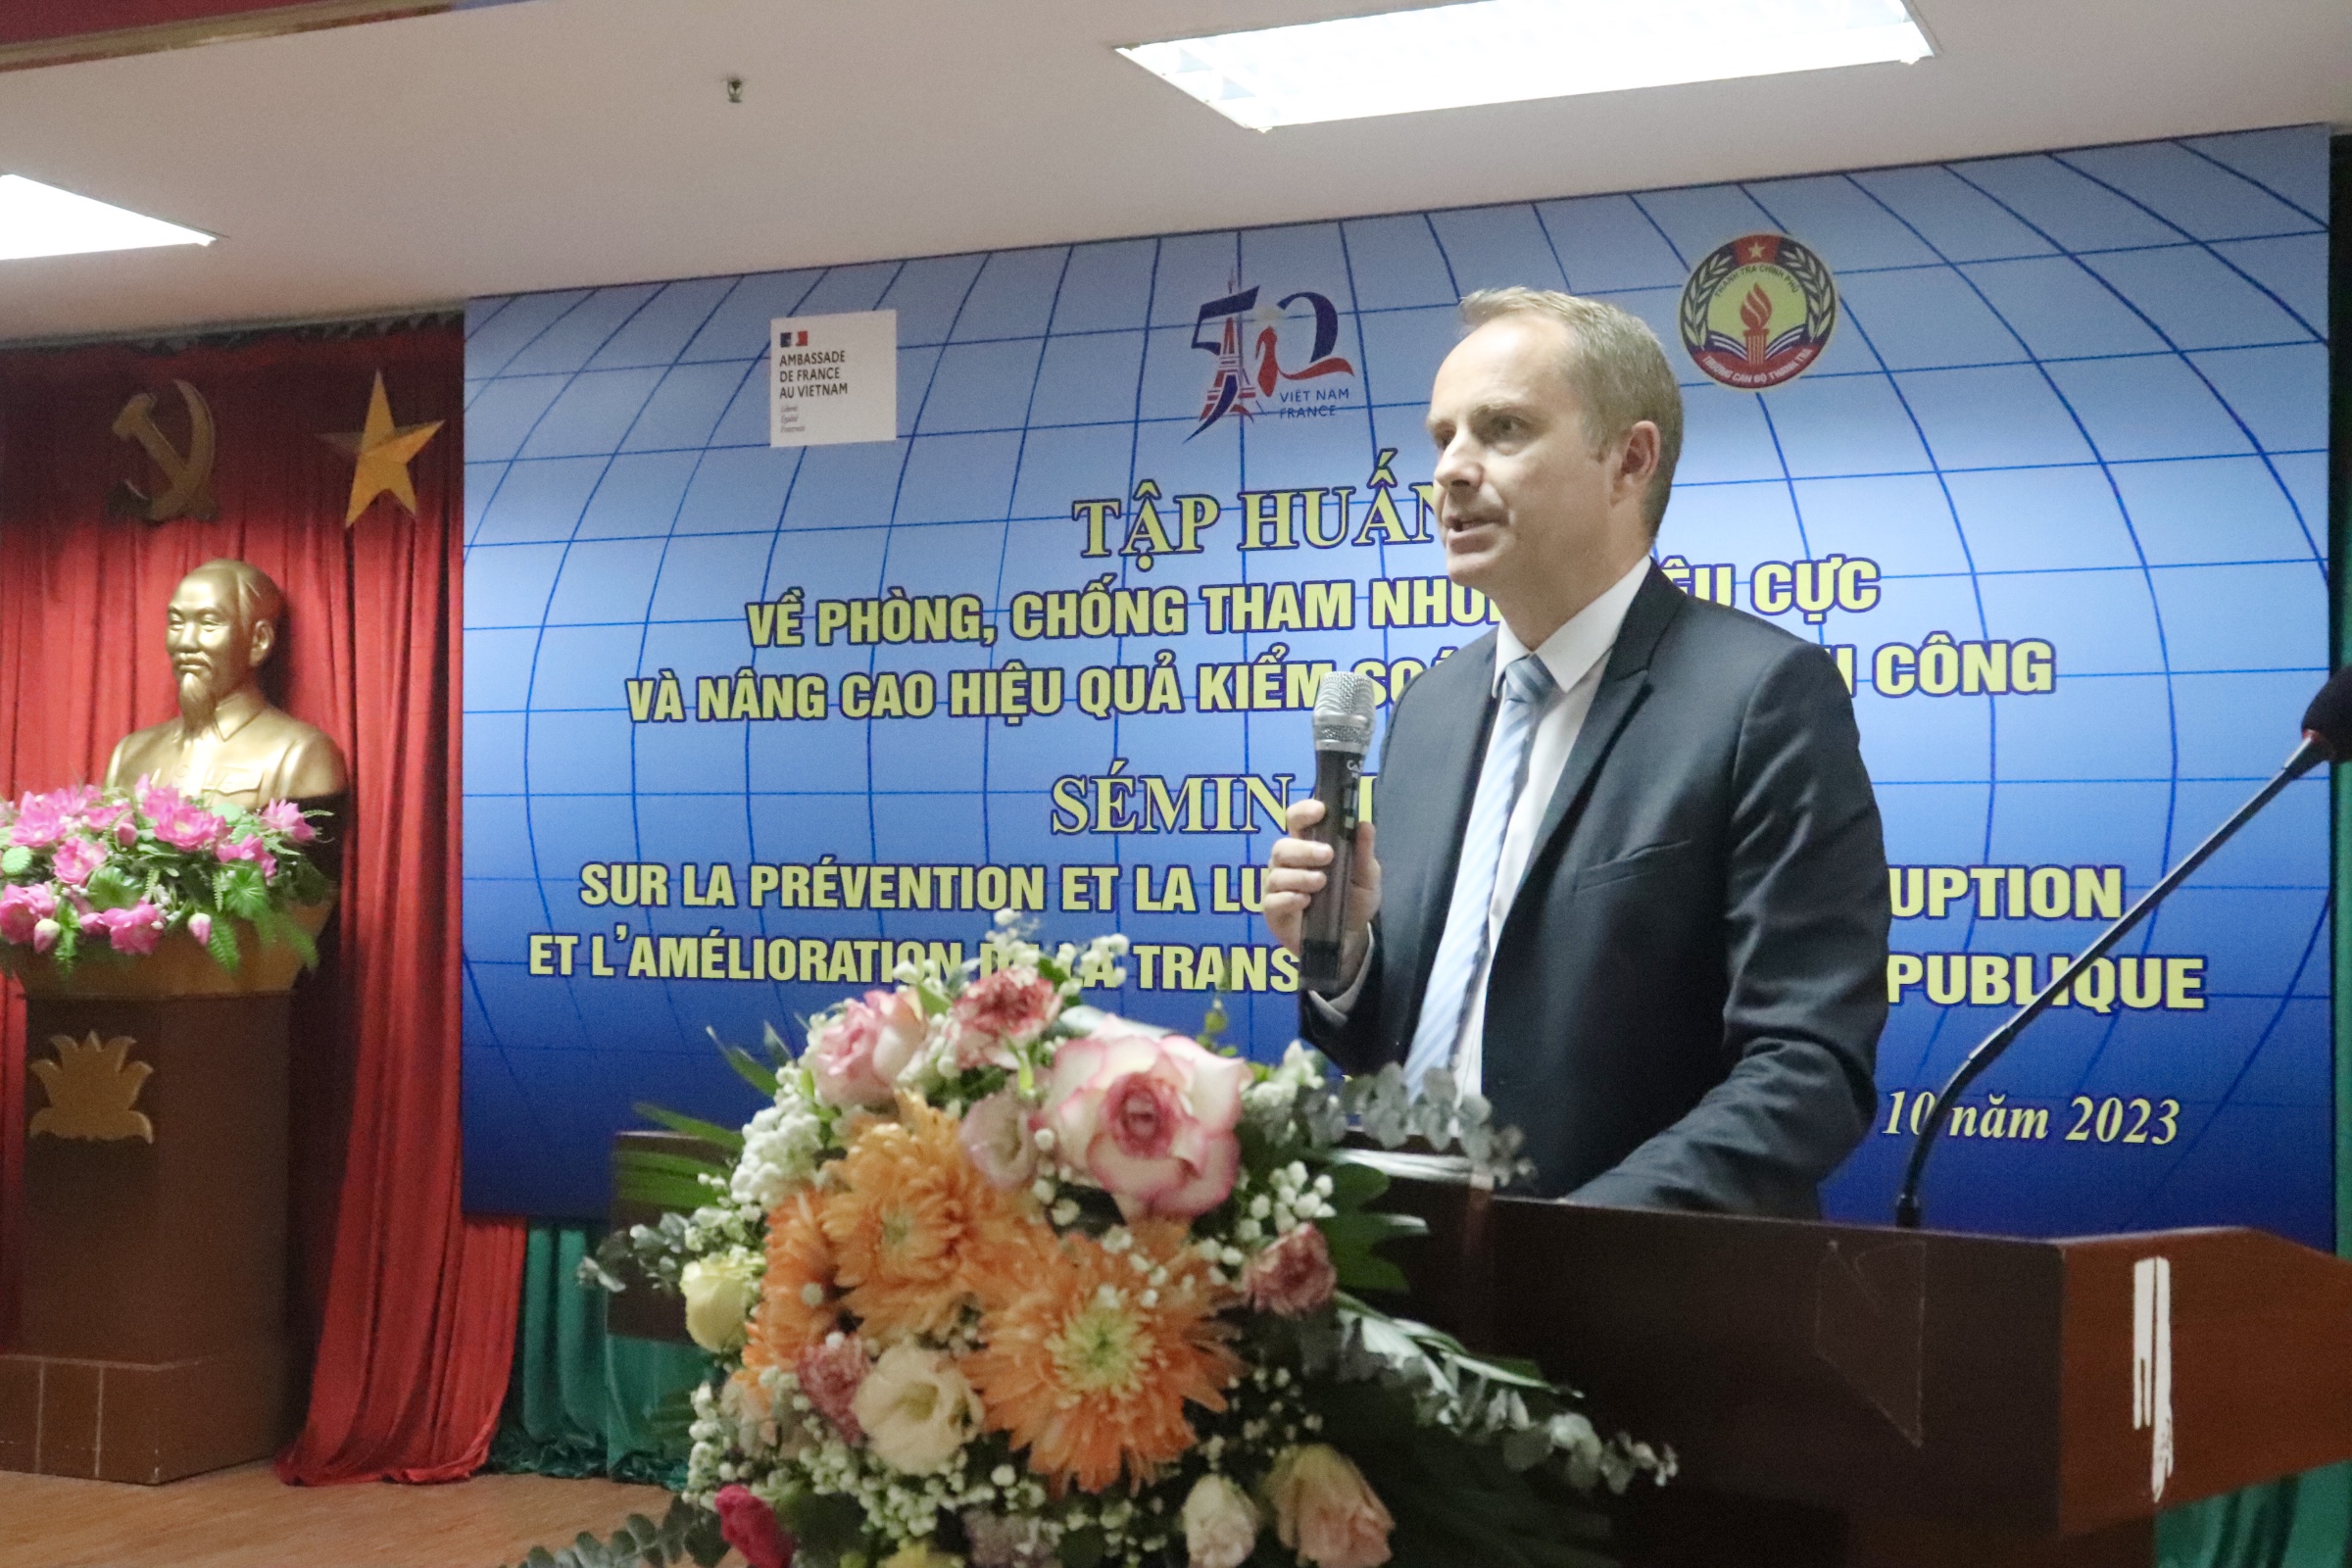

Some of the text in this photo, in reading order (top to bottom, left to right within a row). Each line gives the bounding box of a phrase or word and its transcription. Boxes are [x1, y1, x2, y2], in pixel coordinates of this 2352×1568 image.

[779, 350, 846, 368] AMBASSADE
[779, 367, 841, 383] DE FRANCE
[779, 382, 848, 400] AU VIETNAM
[1279, 405, 1337, 418] FRANCE
[1316, 388, 1349, 400] NAM
[1072, 479, 1221, 571] TẬP
[747, 589, 802, 646] VỀ
[817, 589, 997, 645] PHÒNG,
[1012, 574, 1186, 638] CHỐNG
[1201, 582, 1352, 632] THAM
[1753, 556, 1879, 623] CỰC
[627, 671, 684, 721] VÀ
[698, 668, 826, 720] NÂNG
[841, 672, 934, 718] CAO
[951, 662, 1063, 725] HIỆU
[1079, 651, 1183, 718] QUẢ
[1199, 644, 1333, 710] KIỂM
[1874, 633, 2053, 696] CÔNG
[580, 862, 668, 906] SUR
[683, 864, 736, 906] LA
[750, 856, 1045, 911] PRÉVENTION
[1061, 866, 1120, 911] ET
[1135, 866, 1197, 912] LA
[1888, 867, 2123, 919] UPTION
[529, 934, 579, 976] ET
[1886, 954, 2205, 1013] PUBLIQUE
[1882, 1091, 2181, 1146] 10 năm 2023
